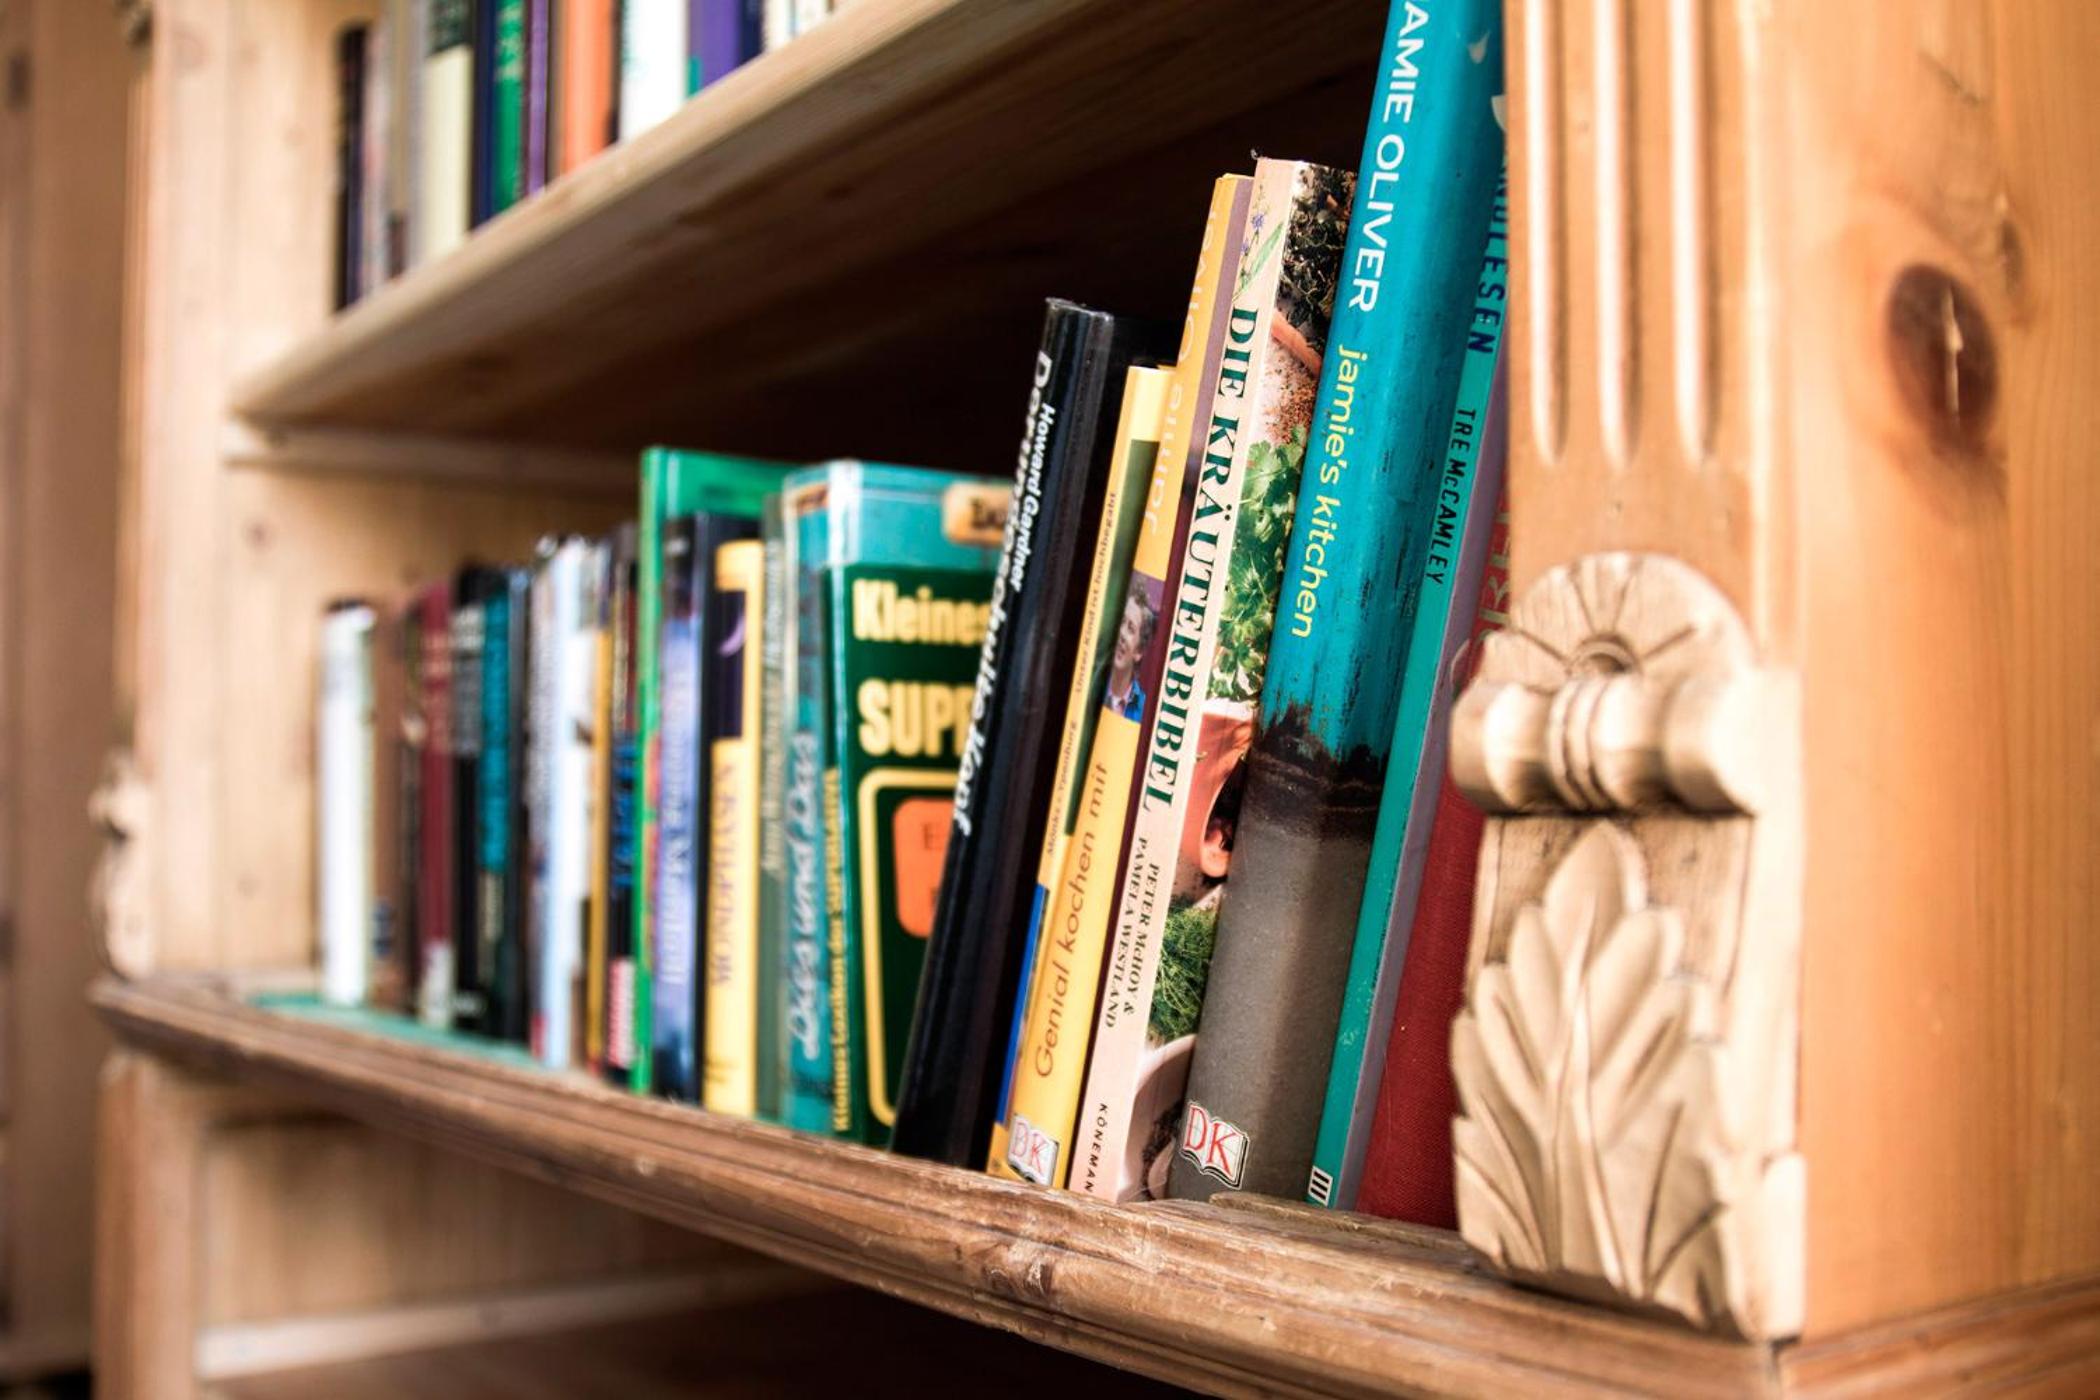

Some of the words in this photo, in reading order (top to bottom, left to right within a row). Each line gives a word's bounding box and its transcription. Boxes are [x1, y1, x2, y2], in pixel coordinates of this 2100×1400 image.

[1383, 0, 1429, 123] AMIE
[1348, 133, 1405, 313] OLIVER
[1217, 307, 1259, 400] DIE
[1026, 402, 1056, 498] Howard
[1144, 381, 1183, 533] Jamie
[1319, 344, 1368, 485] jamie's
[1448, 407, 1477, 453] TRE
[1008, 495, 1041, 594] Gardner
[1083, 610, 1098, 647] Kind
[1091, 491, 1118, 586] hochbegabt
[1291, 495, 1342, 637] kitchen
[1425, 458, 1467, 586] McCAMLEY
[1141, 412, 1241, 813] KRÄUTERBIBEL
[953, 722, 986, 837] Kopf
[1034, 964, 1070, 1079] Genial
[1056, 831, 1096, 954] kochen
[1087, 760, 1110, 820] mit
[1122, 837, 1148, 916] PAMELA
[1138, 864, 1160, 927] PETER
[1104, 923, 1134, 1029] WESTLAND
[1123, 1002, 1136, 1016] &
[1125, 932, 1150, 996] McHOY
[1011, 1119, 1049, 1177] DK
[1184, 1103, 1237, 1181] DK
